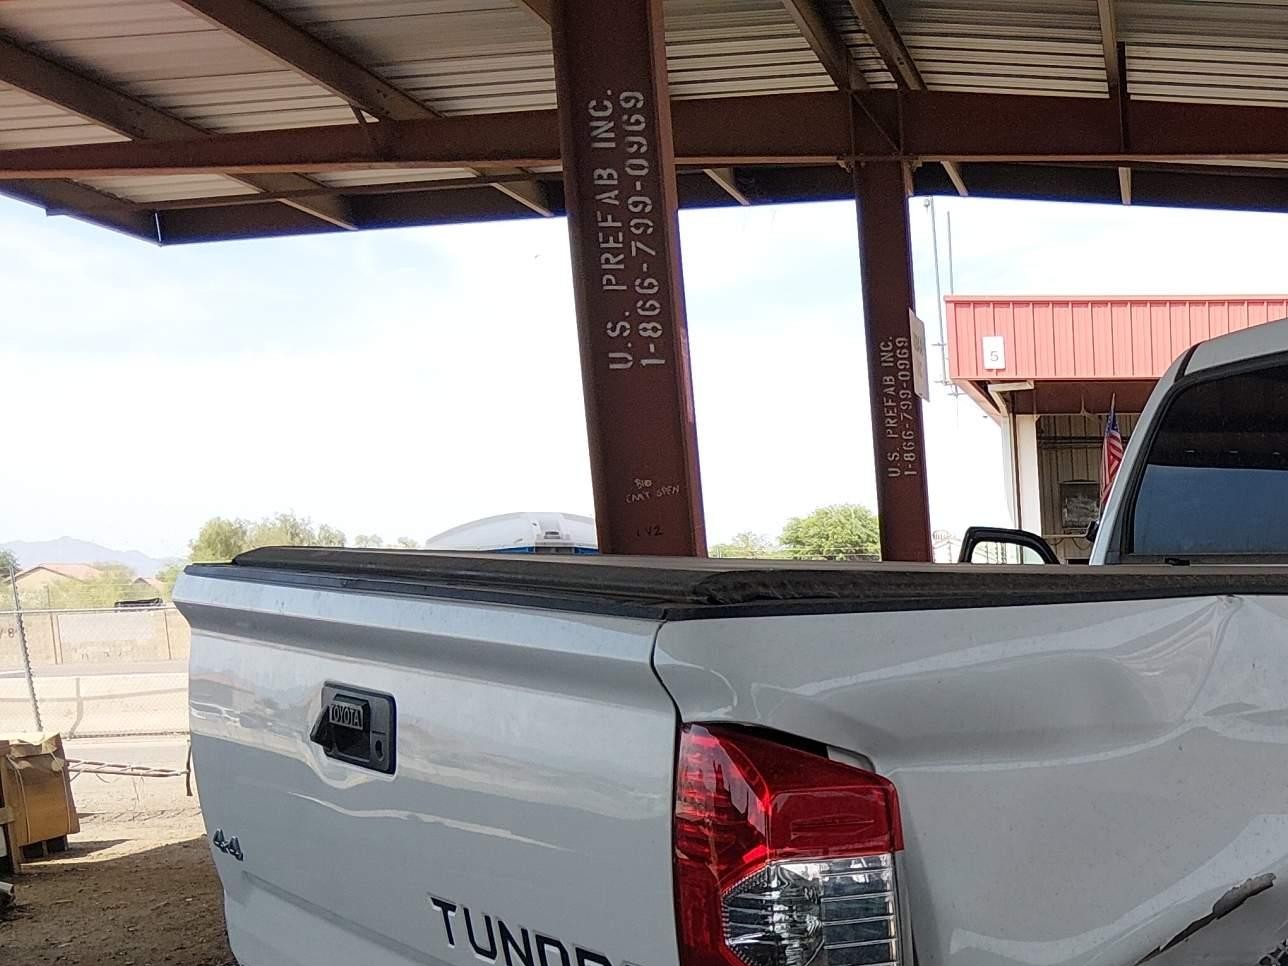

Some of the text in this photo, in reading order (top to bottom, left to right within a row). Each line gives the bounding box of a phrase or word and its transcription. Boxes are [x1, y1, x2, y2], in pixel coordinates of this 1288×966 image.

[588, 89, 633, 369] U.S. PREFAB INC.
[619, 91, 665, 367] 1-866-799-0969
[880, 336, 901, 477] U.S. PREFAB INC.
[990, 351, 999, 362] 5
[330, 704, 363, 729] TOYOTA
